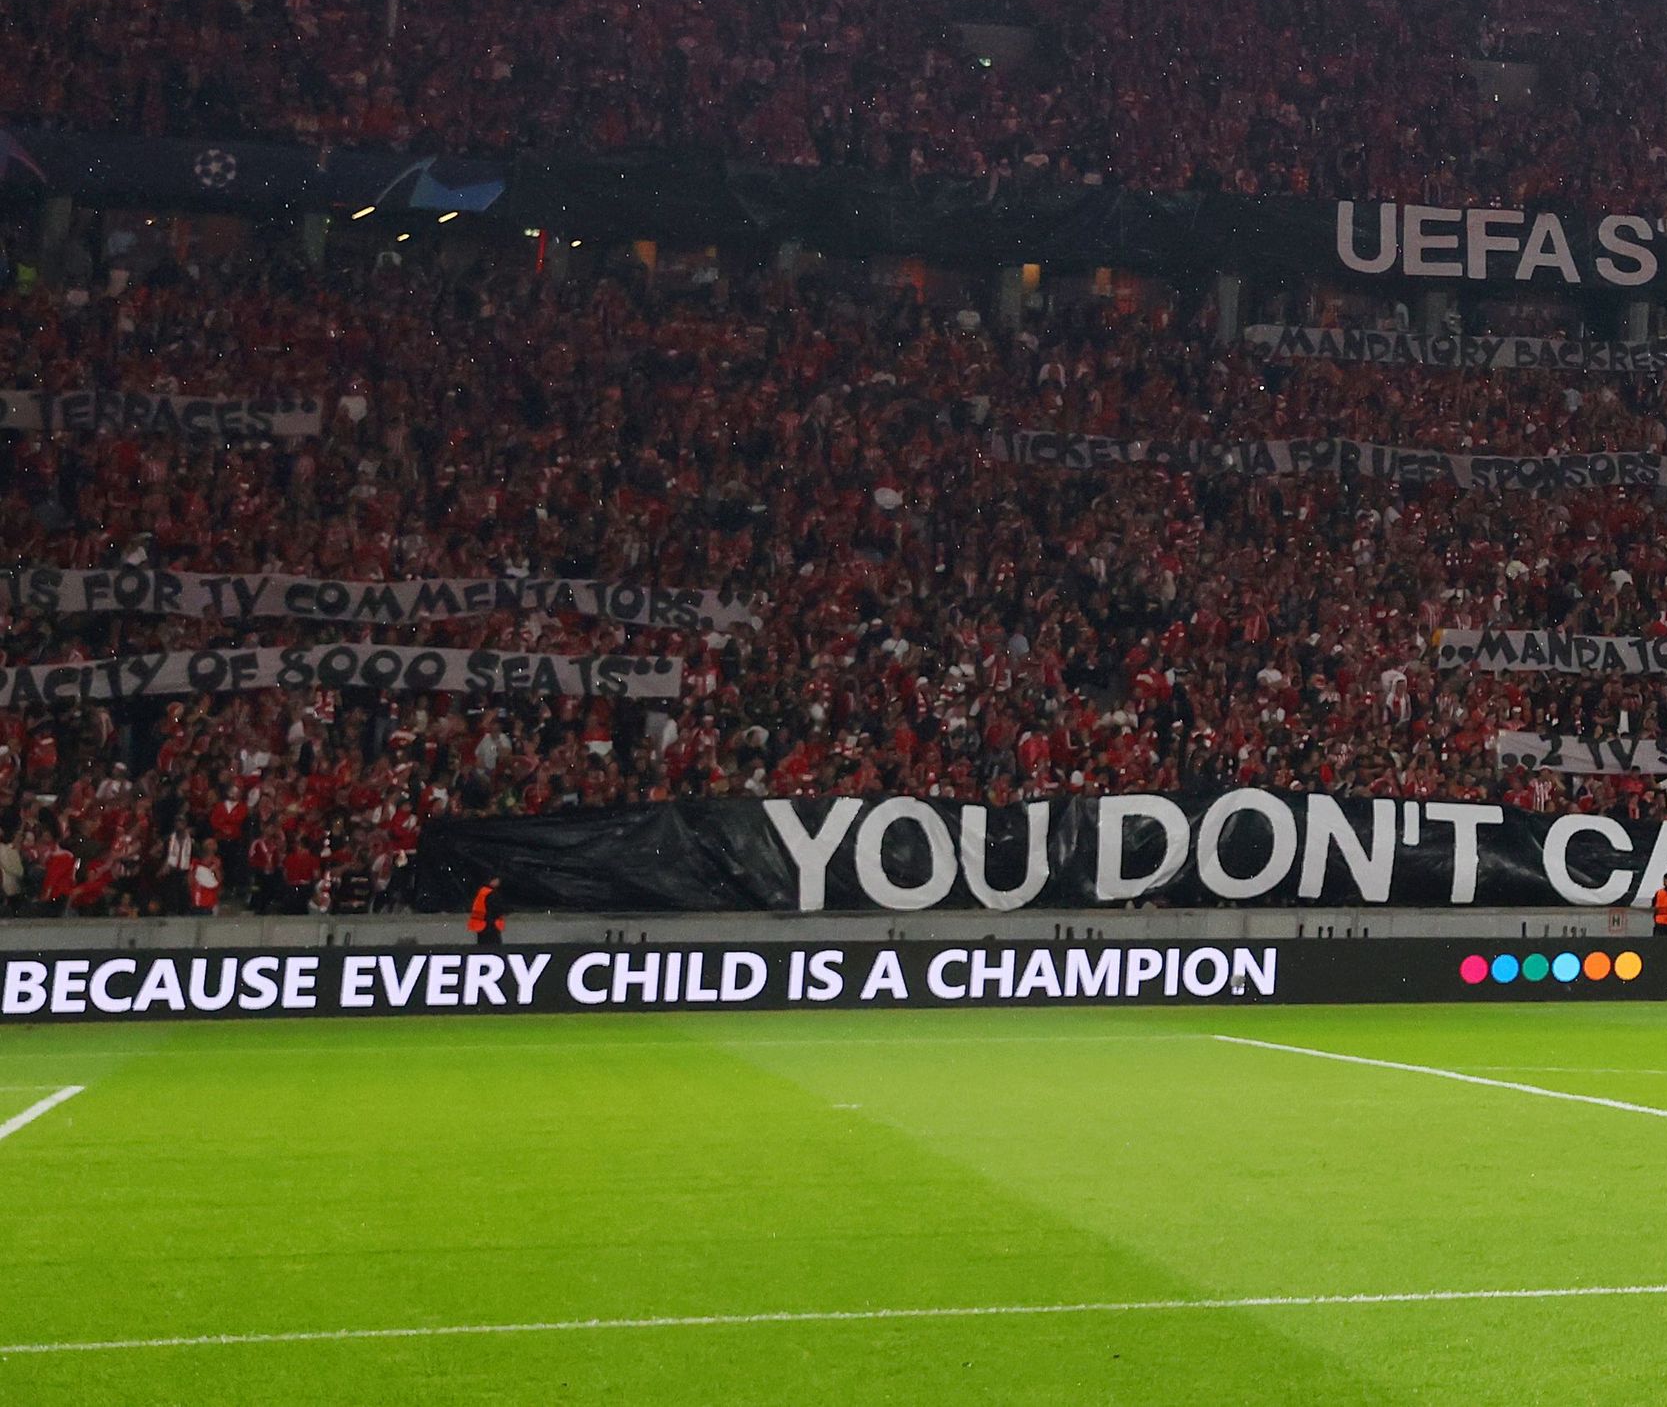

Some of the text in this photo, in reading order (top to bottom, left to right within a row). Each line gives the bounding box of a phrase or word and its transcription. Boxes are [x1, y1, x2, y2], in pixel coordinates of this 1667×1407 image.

[1337, 200, 1581, 283] UEFA
[1471, 452, 1661, 490] SPONSORS
[84, 564, 183, 611] FOR
[201, 576, 272, 620] TV
[188, 650, 259, 691] OF
[276, 646, 445, 691] 8000
[1588, 736, 1639, 771] TV
[762, 795, 1051, 911] YOU
[1095, 787, 1504, 906] DON'T
[2, 946, 1277, 1014] BECAUSE EVERY CHILD IS A CHAMPION
